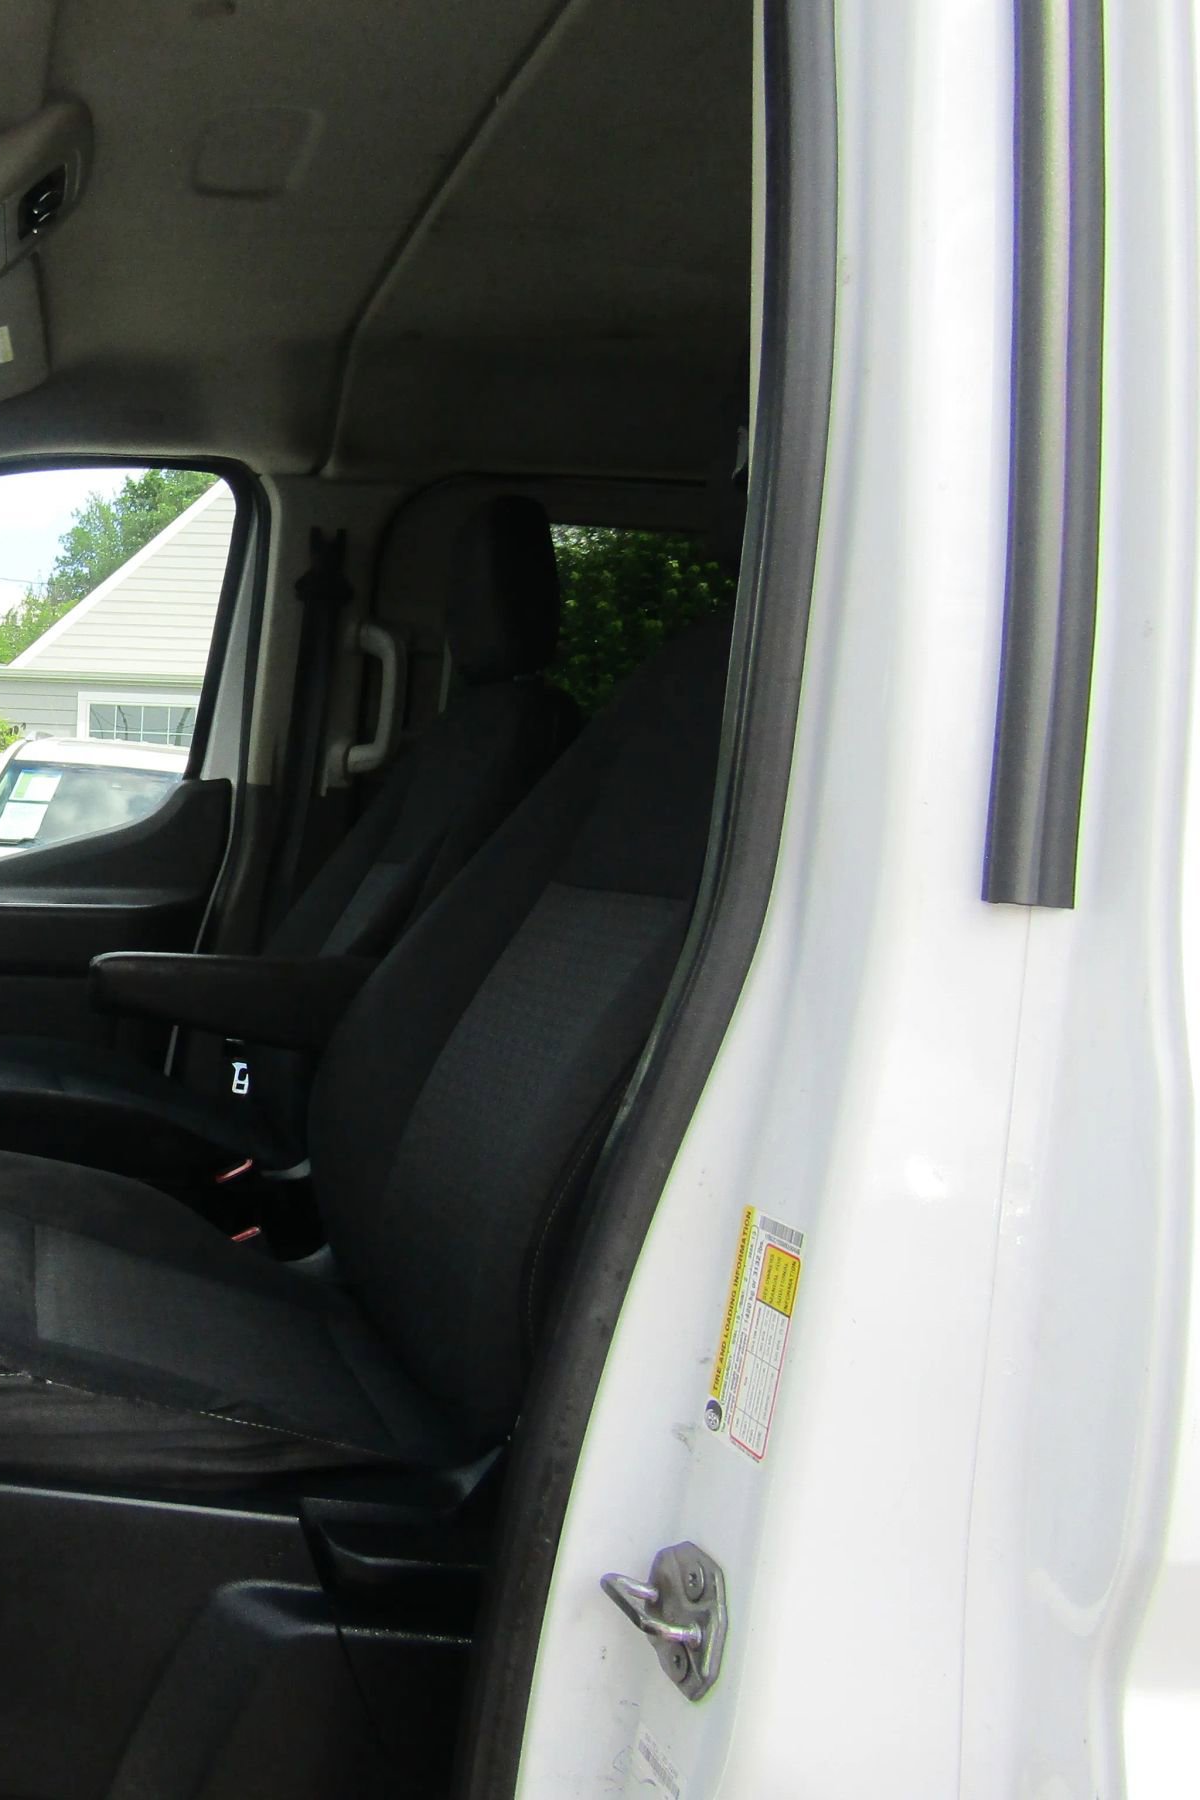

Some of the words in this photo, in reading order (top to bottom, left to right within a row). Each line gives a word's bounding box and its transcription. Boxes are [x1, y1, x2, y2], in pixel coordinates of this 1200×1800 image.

[753, 1254, 761, 1276] 3132
[783, 1260, 796, 1310] INFORMATION
[713, 1367, 722, 1390] TIRE
[719, 1340, 727, 1363] AND
[724, 1288, 737, 1338] LOADING
[733, 1211, 752, 1286] INFORMATION
